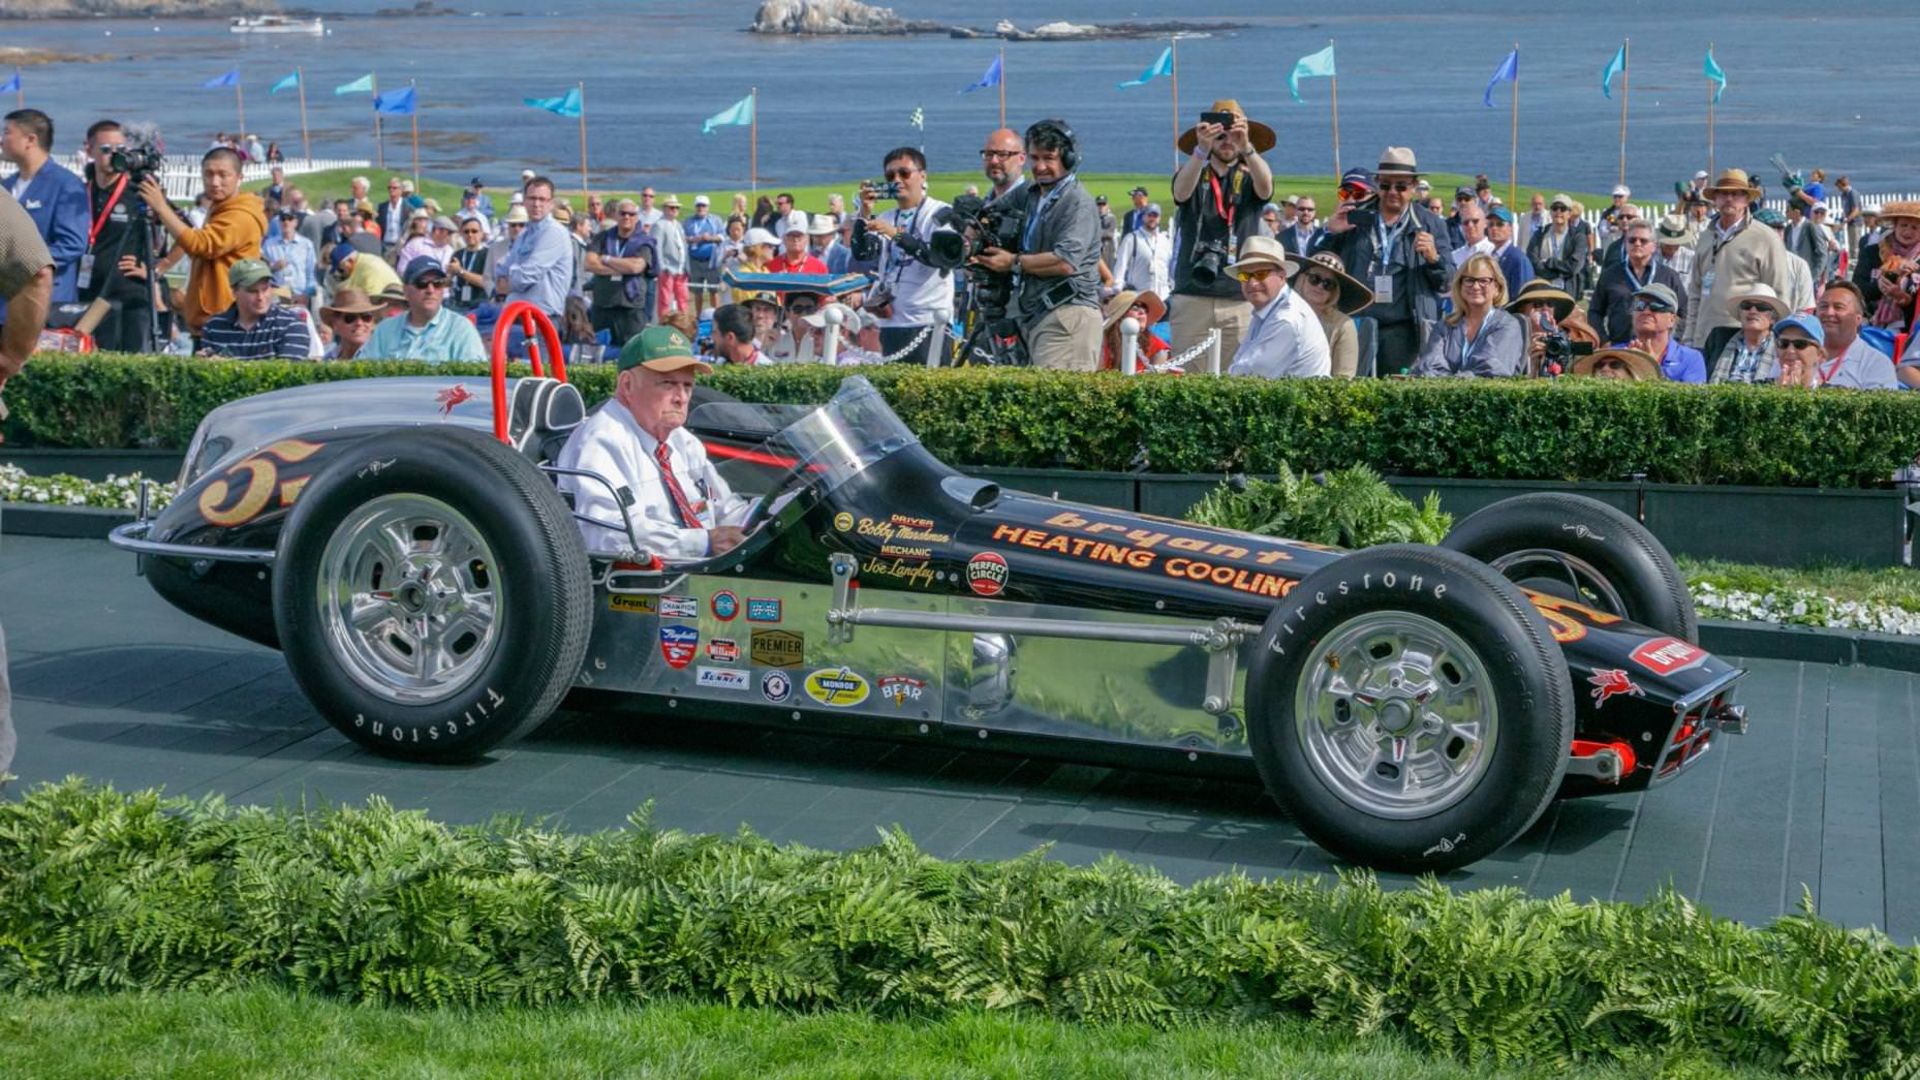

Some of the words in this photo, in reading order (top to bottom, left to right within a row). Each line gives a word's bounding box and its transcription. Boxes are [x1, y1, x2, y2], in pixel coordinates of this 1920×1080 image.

[891, 514, 934, 527] DRIVER
[857, 518, 896, 542] Bobby
[1044, 511, 1294, 564] bryant
[881, 545, 932, 557] MECHANIC
[991, 523, 1157, 569] HEATING
[863, 557, 888, 575] Joe
[885, 559, 935, 588] Langley
[969, 561, 1008, 574] PERFECT
[970, 570, 1003, 583] CIRCLE
[612, 595, 649, 608] Grant
[663, 602, 696, 611] CHAMPION
[1268, 571, 1447, 656] Firestone
[753, 637, 802, 653] PREMIER
[822, 680, 854, 690] MONROE
[881, 683, 922, 701] BEAR
[354, 687, 505, 742] Firestone
